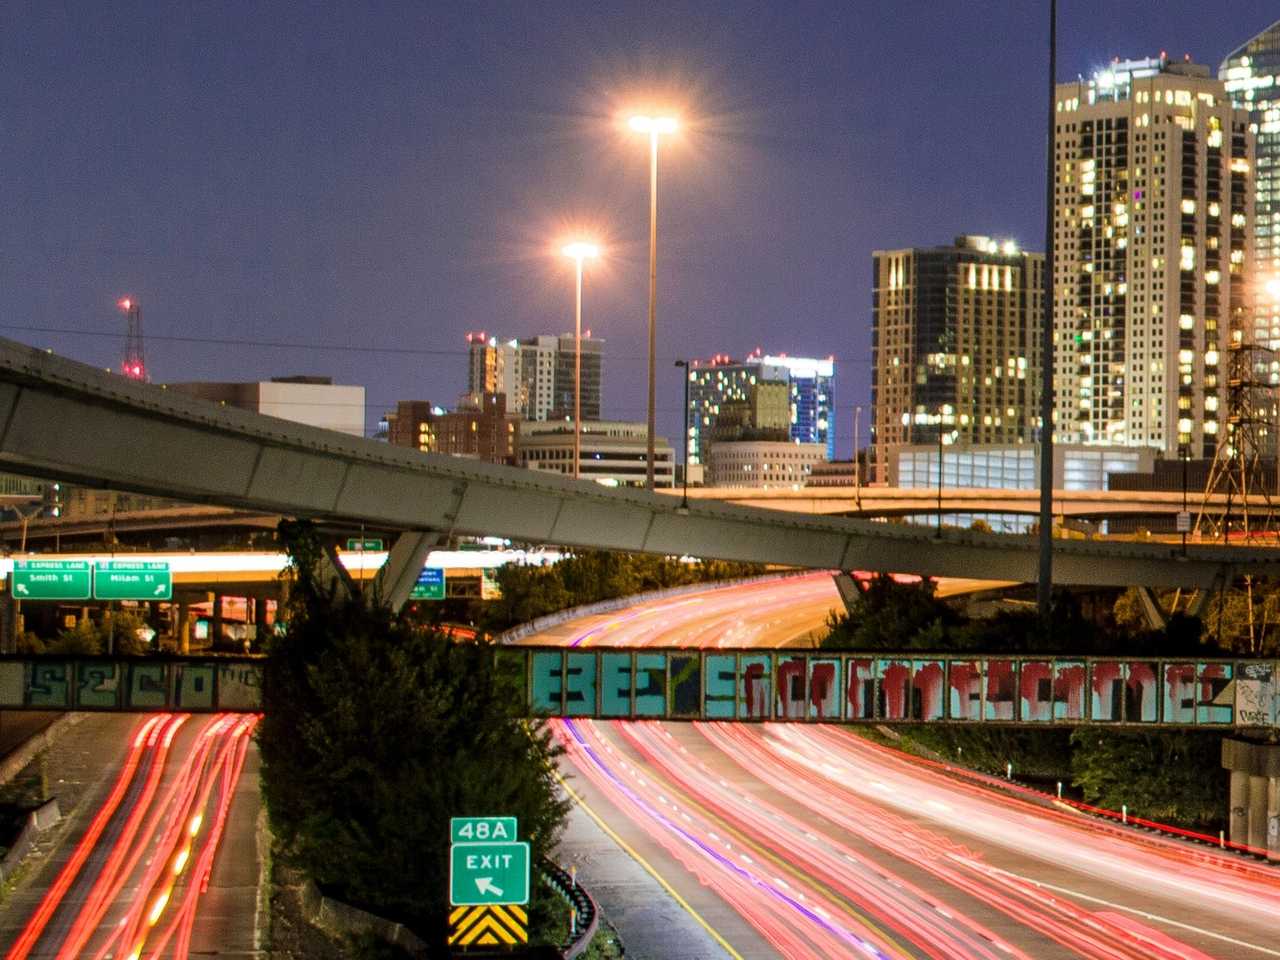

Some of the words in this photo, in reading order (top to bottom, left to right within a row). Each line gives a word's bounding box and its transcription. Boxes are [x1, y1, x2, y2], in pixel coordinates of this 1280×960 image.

[29, 574, 58, 582] Smith
[63, 574, 73, 582] St
[110, 574, 140, 582] Milam
[144, 574, 154, 582] St
[458, 821, 508, 839] 48A
[465, 852, 513, 870] EXIT
